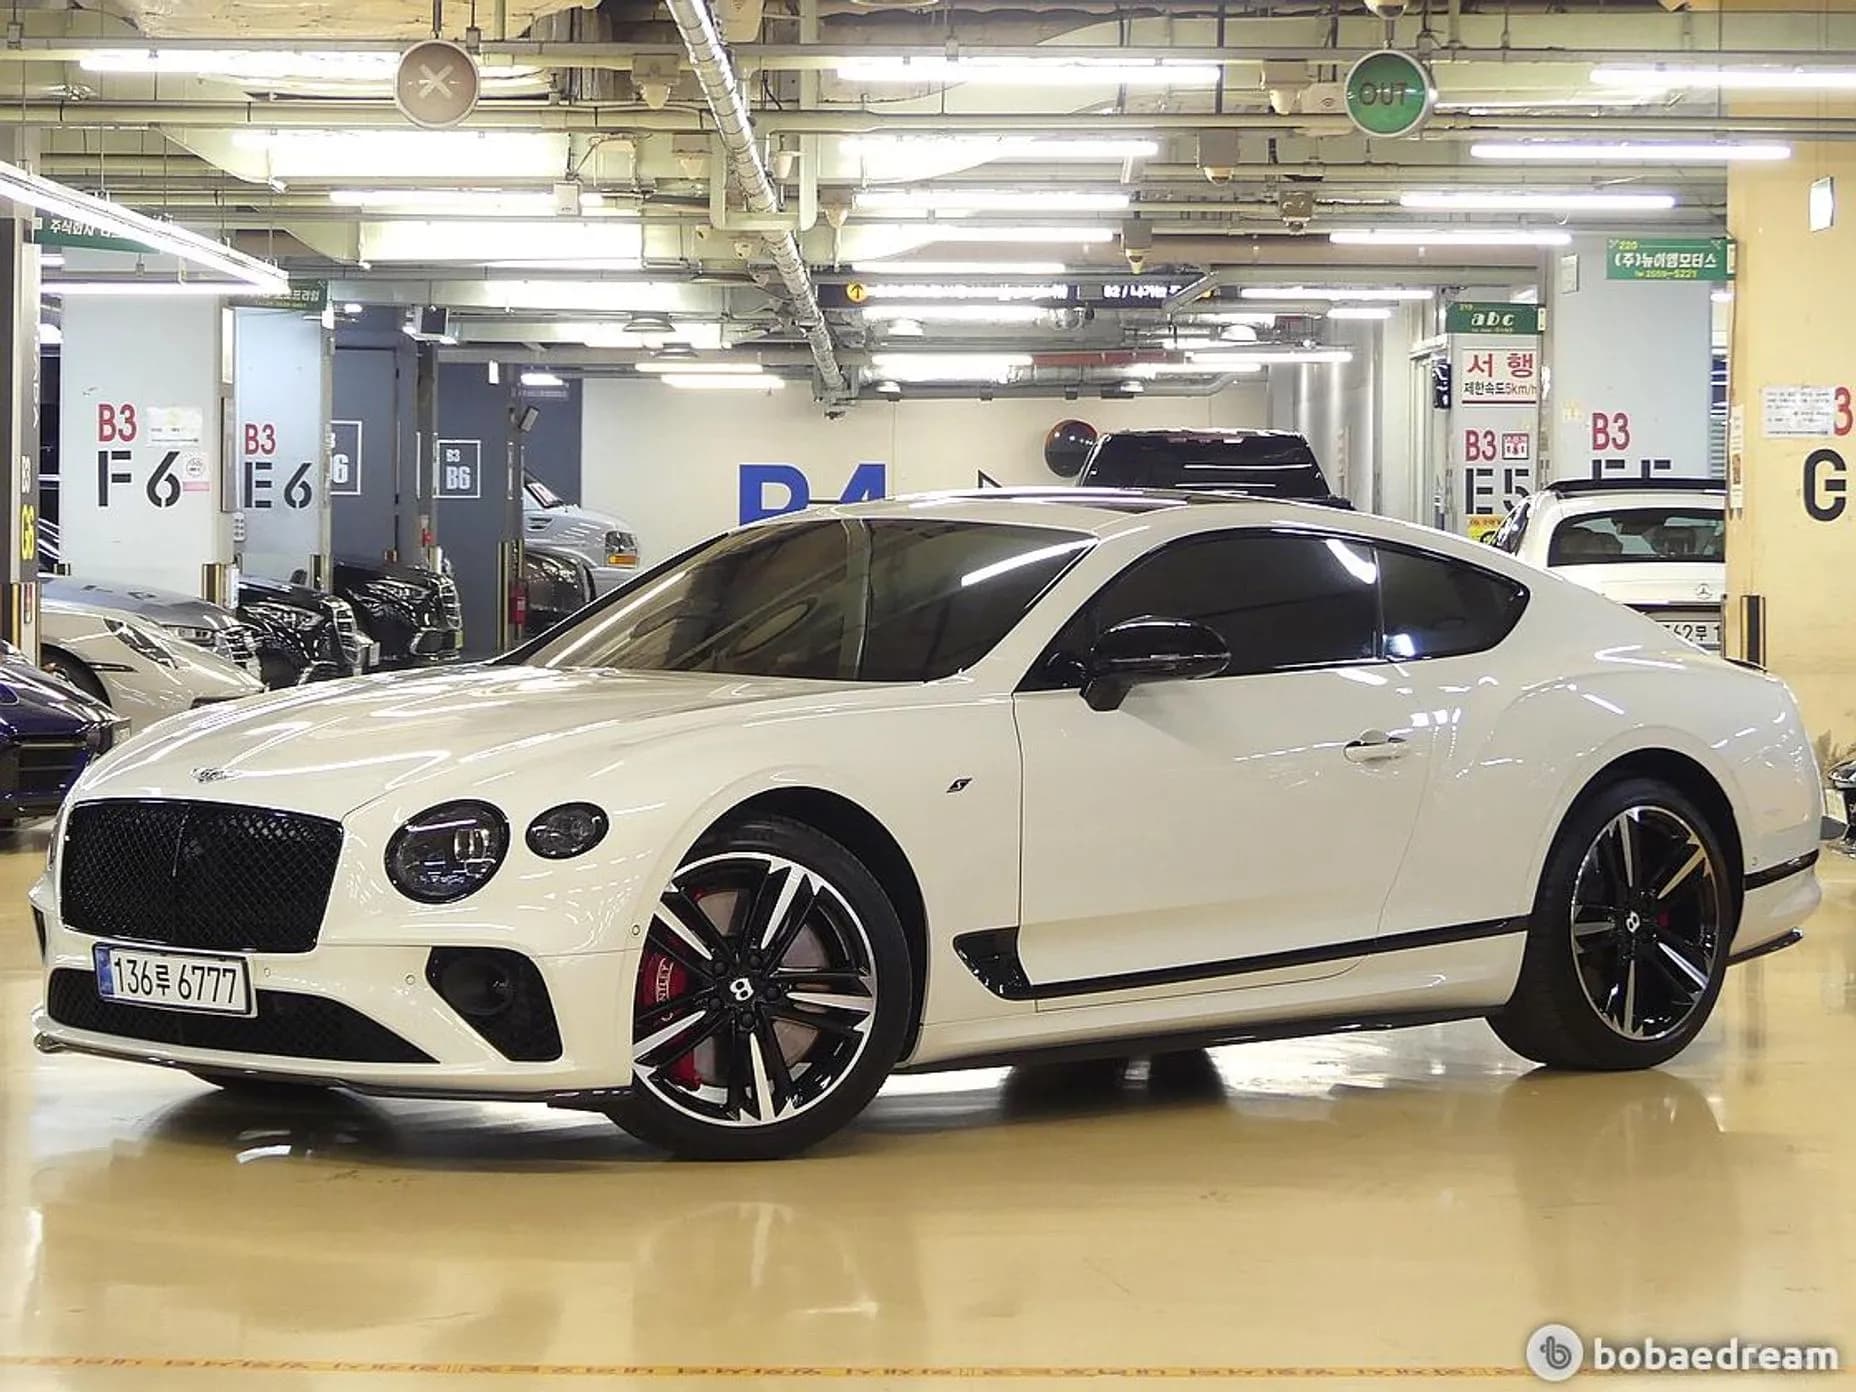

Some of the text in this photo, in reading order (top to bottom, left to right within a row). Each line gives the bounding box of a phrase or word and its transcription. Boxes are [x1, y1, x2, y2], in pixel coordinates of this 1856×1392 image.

[1361, 82, 1407, 105] OUT
[1471, 311, 1515, 326] abc
[98, 403, 137, 442] B3
[1834, 387, 1853, 436] 3
[245, 424, 275, 455] B3
[1465, 430, 1496, 461] B3
[1592, 413, 1630, 450] B3
[446, 466, 471, 490] B6
[113, 957, 171, 996] 136루
[178, 963, 237, 1004] 6777
